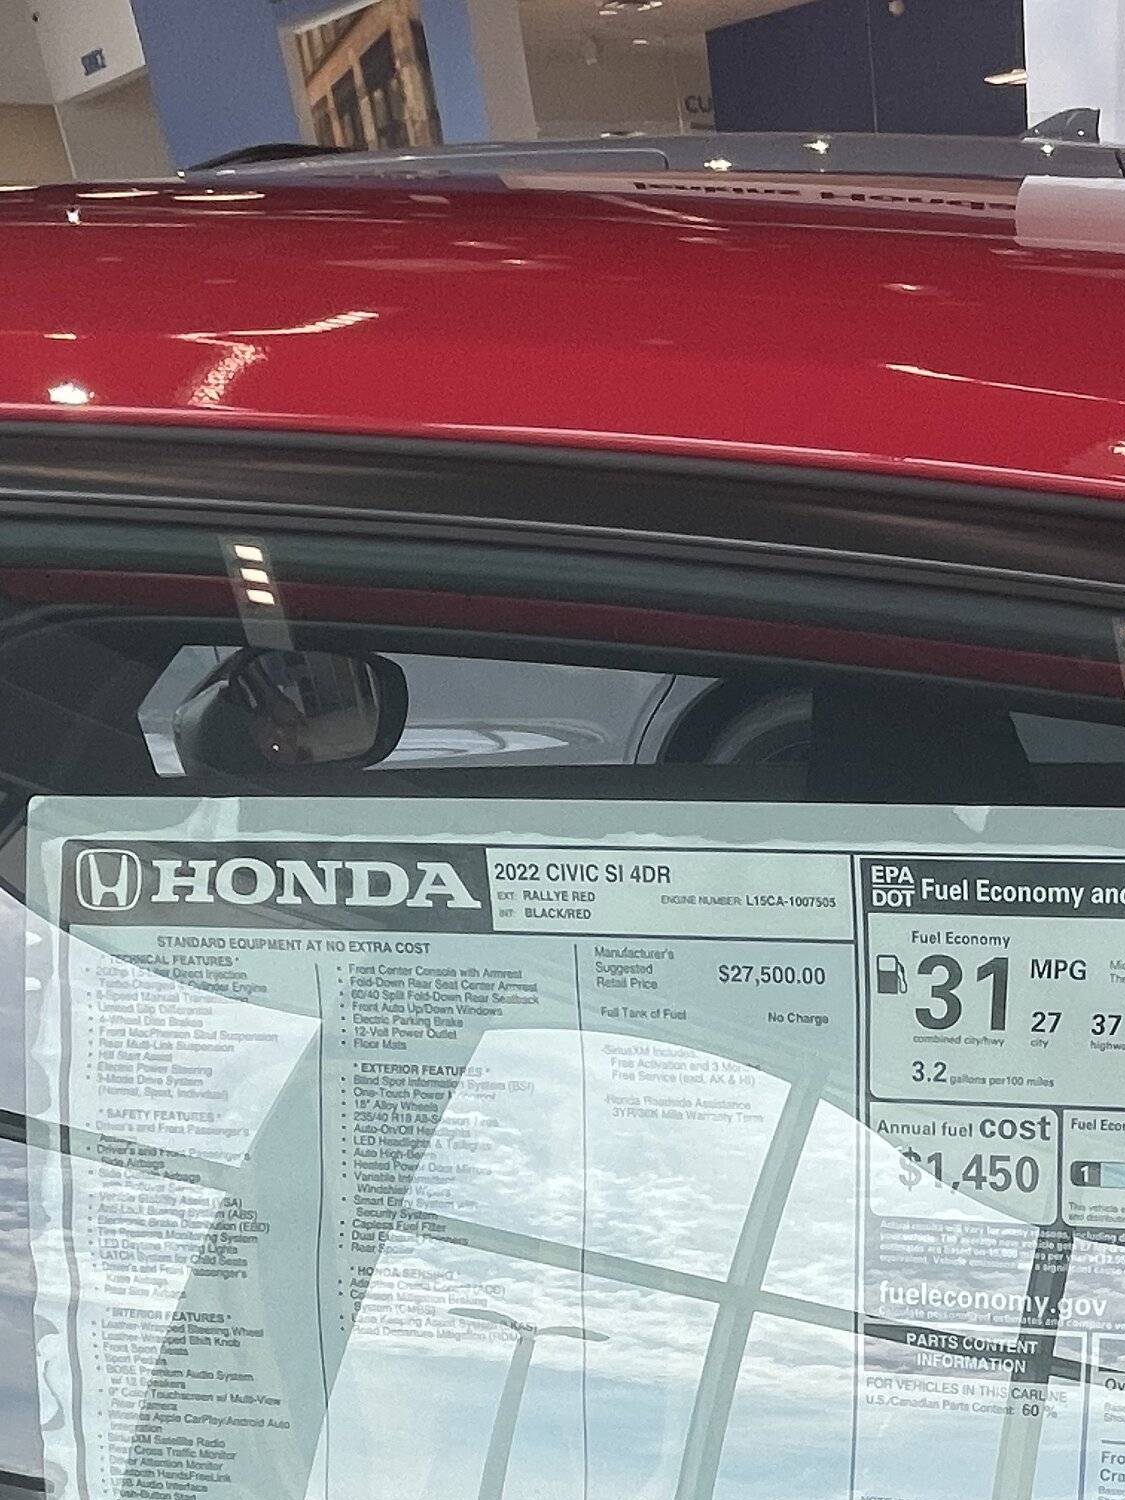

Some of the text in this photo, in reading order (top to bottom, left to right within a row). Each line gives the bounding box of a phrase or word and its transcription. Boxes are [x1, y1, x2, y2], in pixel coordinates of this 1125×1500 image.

[151, 857, 481, 909] HONDA
[494, 864, 671, 884] 2022 CIVIC SI 4DR
[871, 866, 914, 885] EPA
[522, 890, 596, 902] RALLYE RED
[872, 889, 915, 909] DOT
[921, 879, 970, 902] Fuel
[977, 880, 1086, 907] Economy
[524, 908, 591, 920] BLACK/RED
[158, 936, 430, 955] STANDARD EQUIPMENT AT NO EXTRA COST
[912, 930, 1010, 949] Fuel Economy
[595, 946, 674, 960] Manufacturer's
[595, 962, 652, 976] Suggested
[718, 964, 826, 986] $27,500.00
[1030, 959, 1088, 981] MPG
[597, 978, 658, 991] Retail Price
[914, 953, 1009, 1033] 31
[1030, 1011, 1122, 1037] 27 37
[1030, 1038, 1048, 1050] city
[912, 1061, 947, 1084] 3.2
[878, 1115, 1051, 1141] Annual fuel cost
[1071, 1118, 1097, 1131] Fuel
[899, 1146, 1040, 1193] $1,450
[1080, 1166, 1090, 1183] 1
[879, 1280, 1108, 1318] fueleconomy.gov
[907, 1333, 1038, 1354] PARTS CONTENT
[917, 1352, 1027, 1373] INFORMATION
[1022, 1404, 1039, 1417] 60
